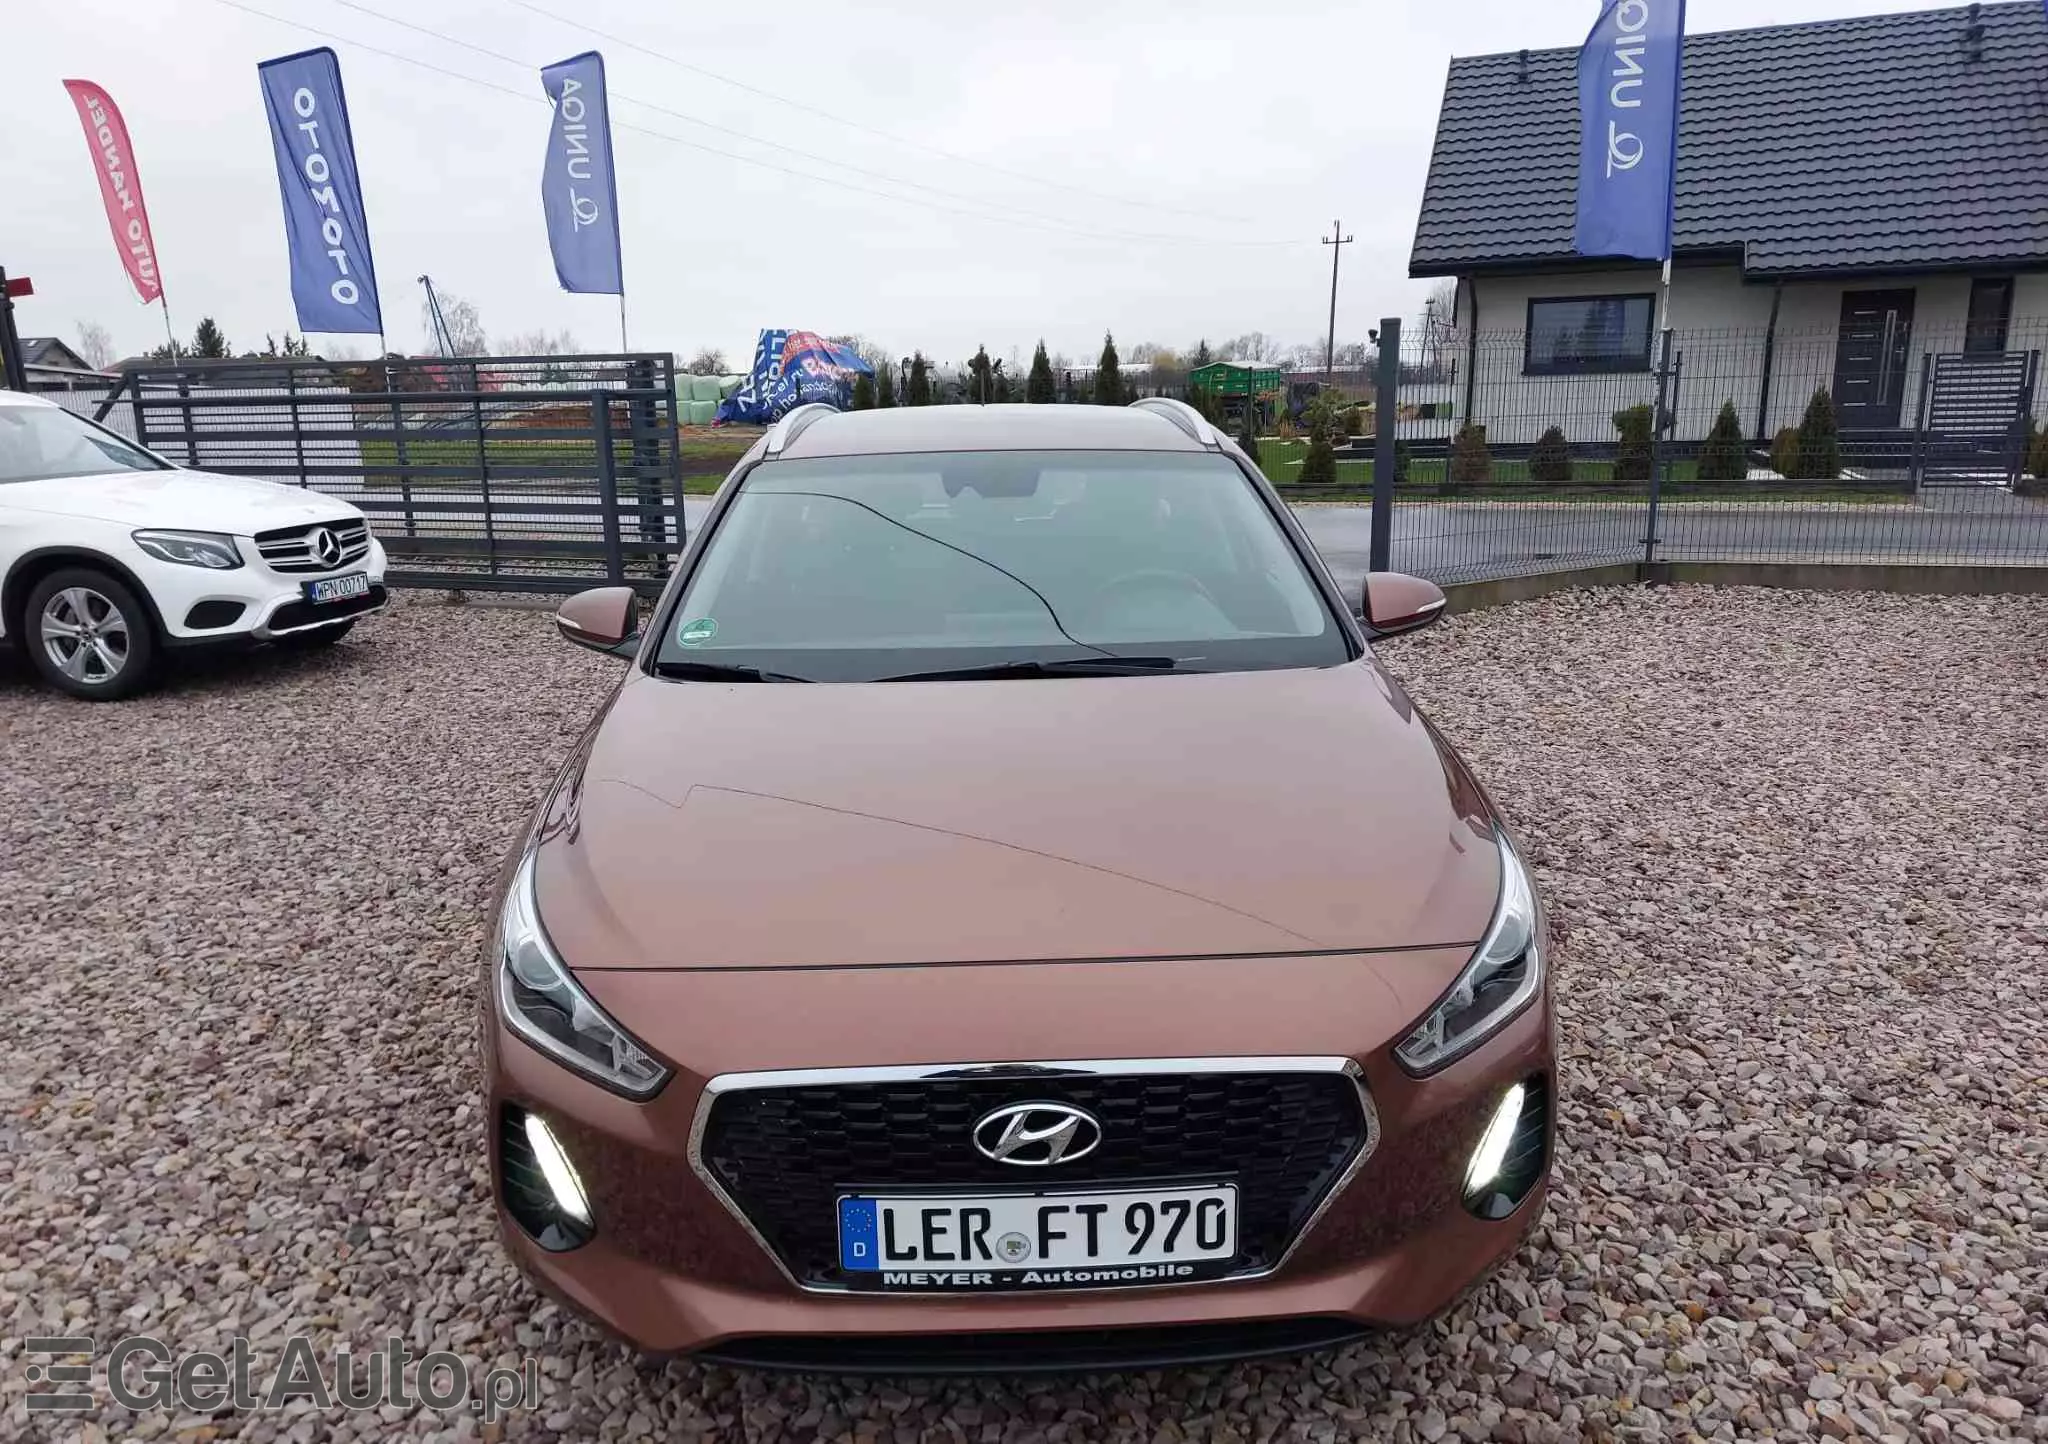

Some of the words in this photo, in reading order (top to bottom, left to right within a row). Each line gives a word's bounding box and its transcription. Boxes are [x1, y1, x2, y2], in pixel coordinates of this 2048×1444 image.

[294, 87, 360, 305] OTOMOTO
[853, 1242, 866, 1257] D
[882, 1207, 993, 1261] LER
[1037, 1203, 1109, 1259] FT
[1124, 1197, 1227, 1256] 970
[883, 1271, 993, 1286] MEYER
[1021, 1262, 1195, 1284] Automobile
